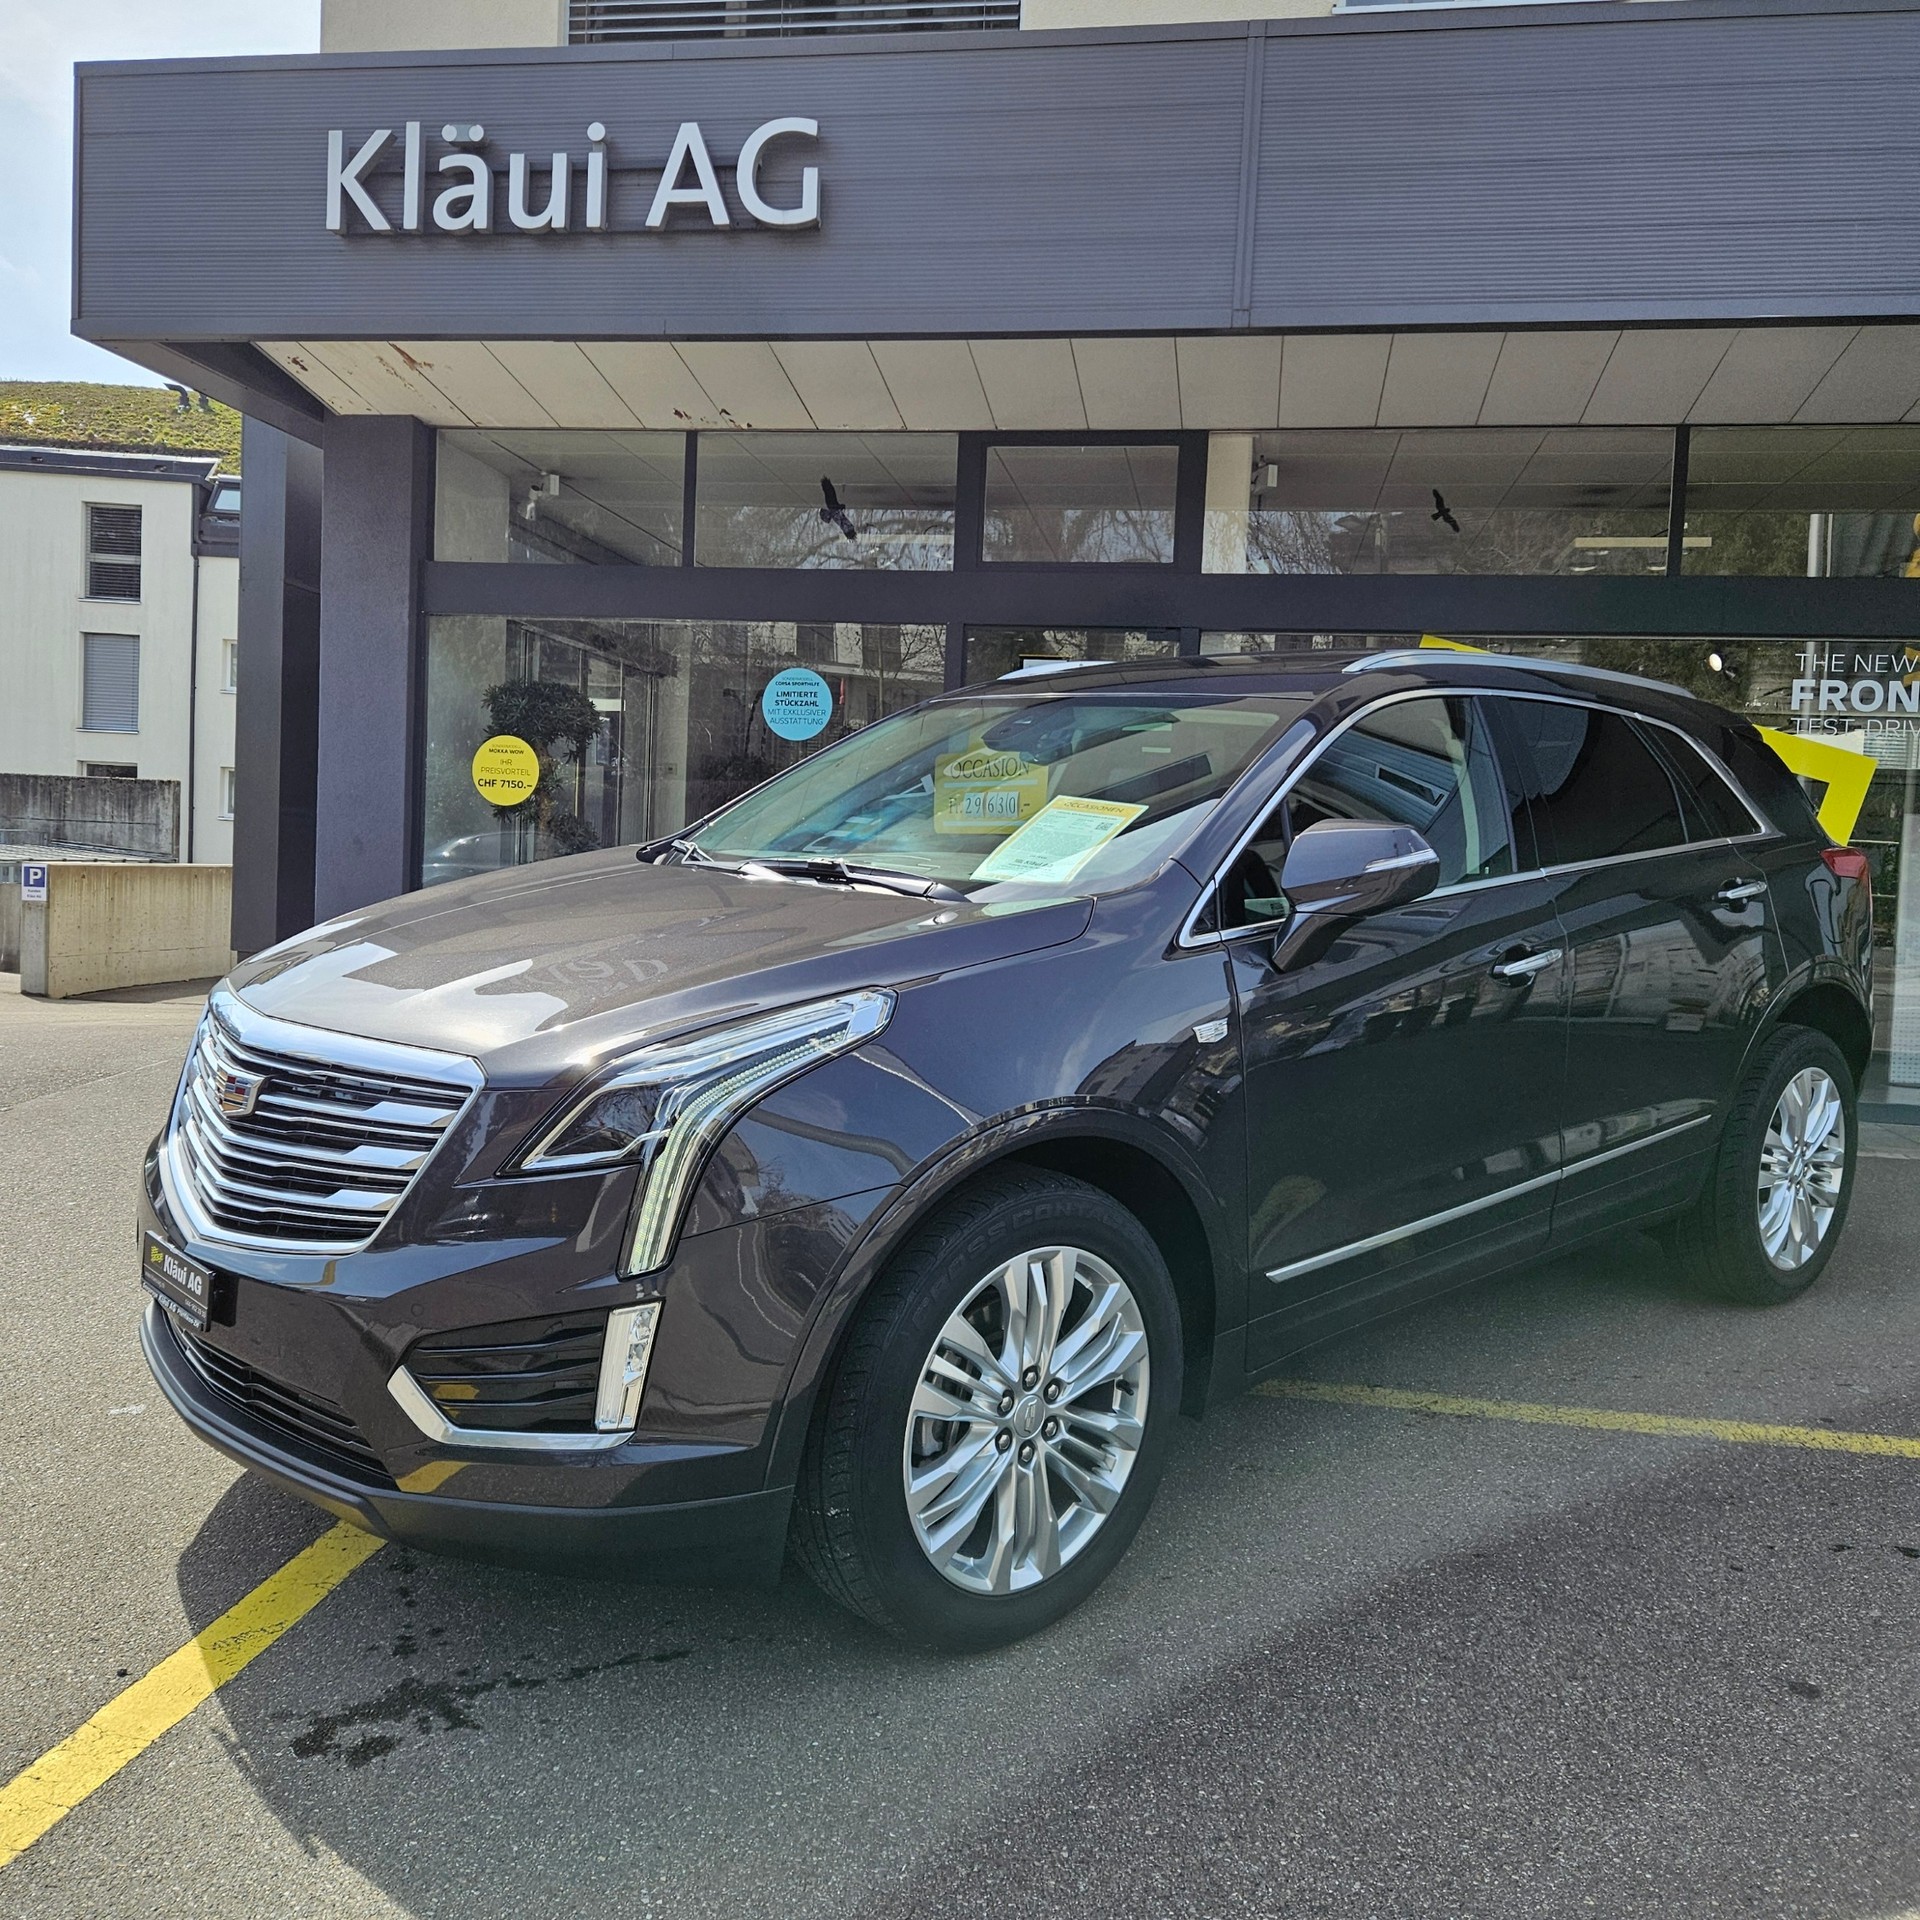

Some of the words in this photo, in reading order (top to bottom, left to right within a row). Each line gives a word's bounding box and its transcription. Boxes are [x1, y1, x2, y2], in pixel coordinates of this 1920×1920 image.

[326, 121, 605, 230] Kläui
[645, 117, 818, 227] AG
[1795, 653, 1845, 673] THE
[1854, 654, 1919, 673] NEW
[776, 690, 818, 698] LIMITIERTE
[1790, 679, 1920, 713] FRON
[774, 698, 819, 707] STÜCKZAHL
[767, 708, 781, 716] MIT
[783, 709, 826, 717] EXKLUSIVER
[769, 717, 823, 726] AUSSTATTUNG
[1790, 717, 1855, 736] TEST
[480, 766, 531, 776] PREISVORTEIL
[951, 757, 1030, 779] OCCASION
[477, 778, 497, 788] CHF
[1064, 801, 1125, 813] OCCASIONEN
[29, 868, 42, 885] P
[163, 1254, 187, 1285] Kläui
[187, 1272, 202, 1296] AG
